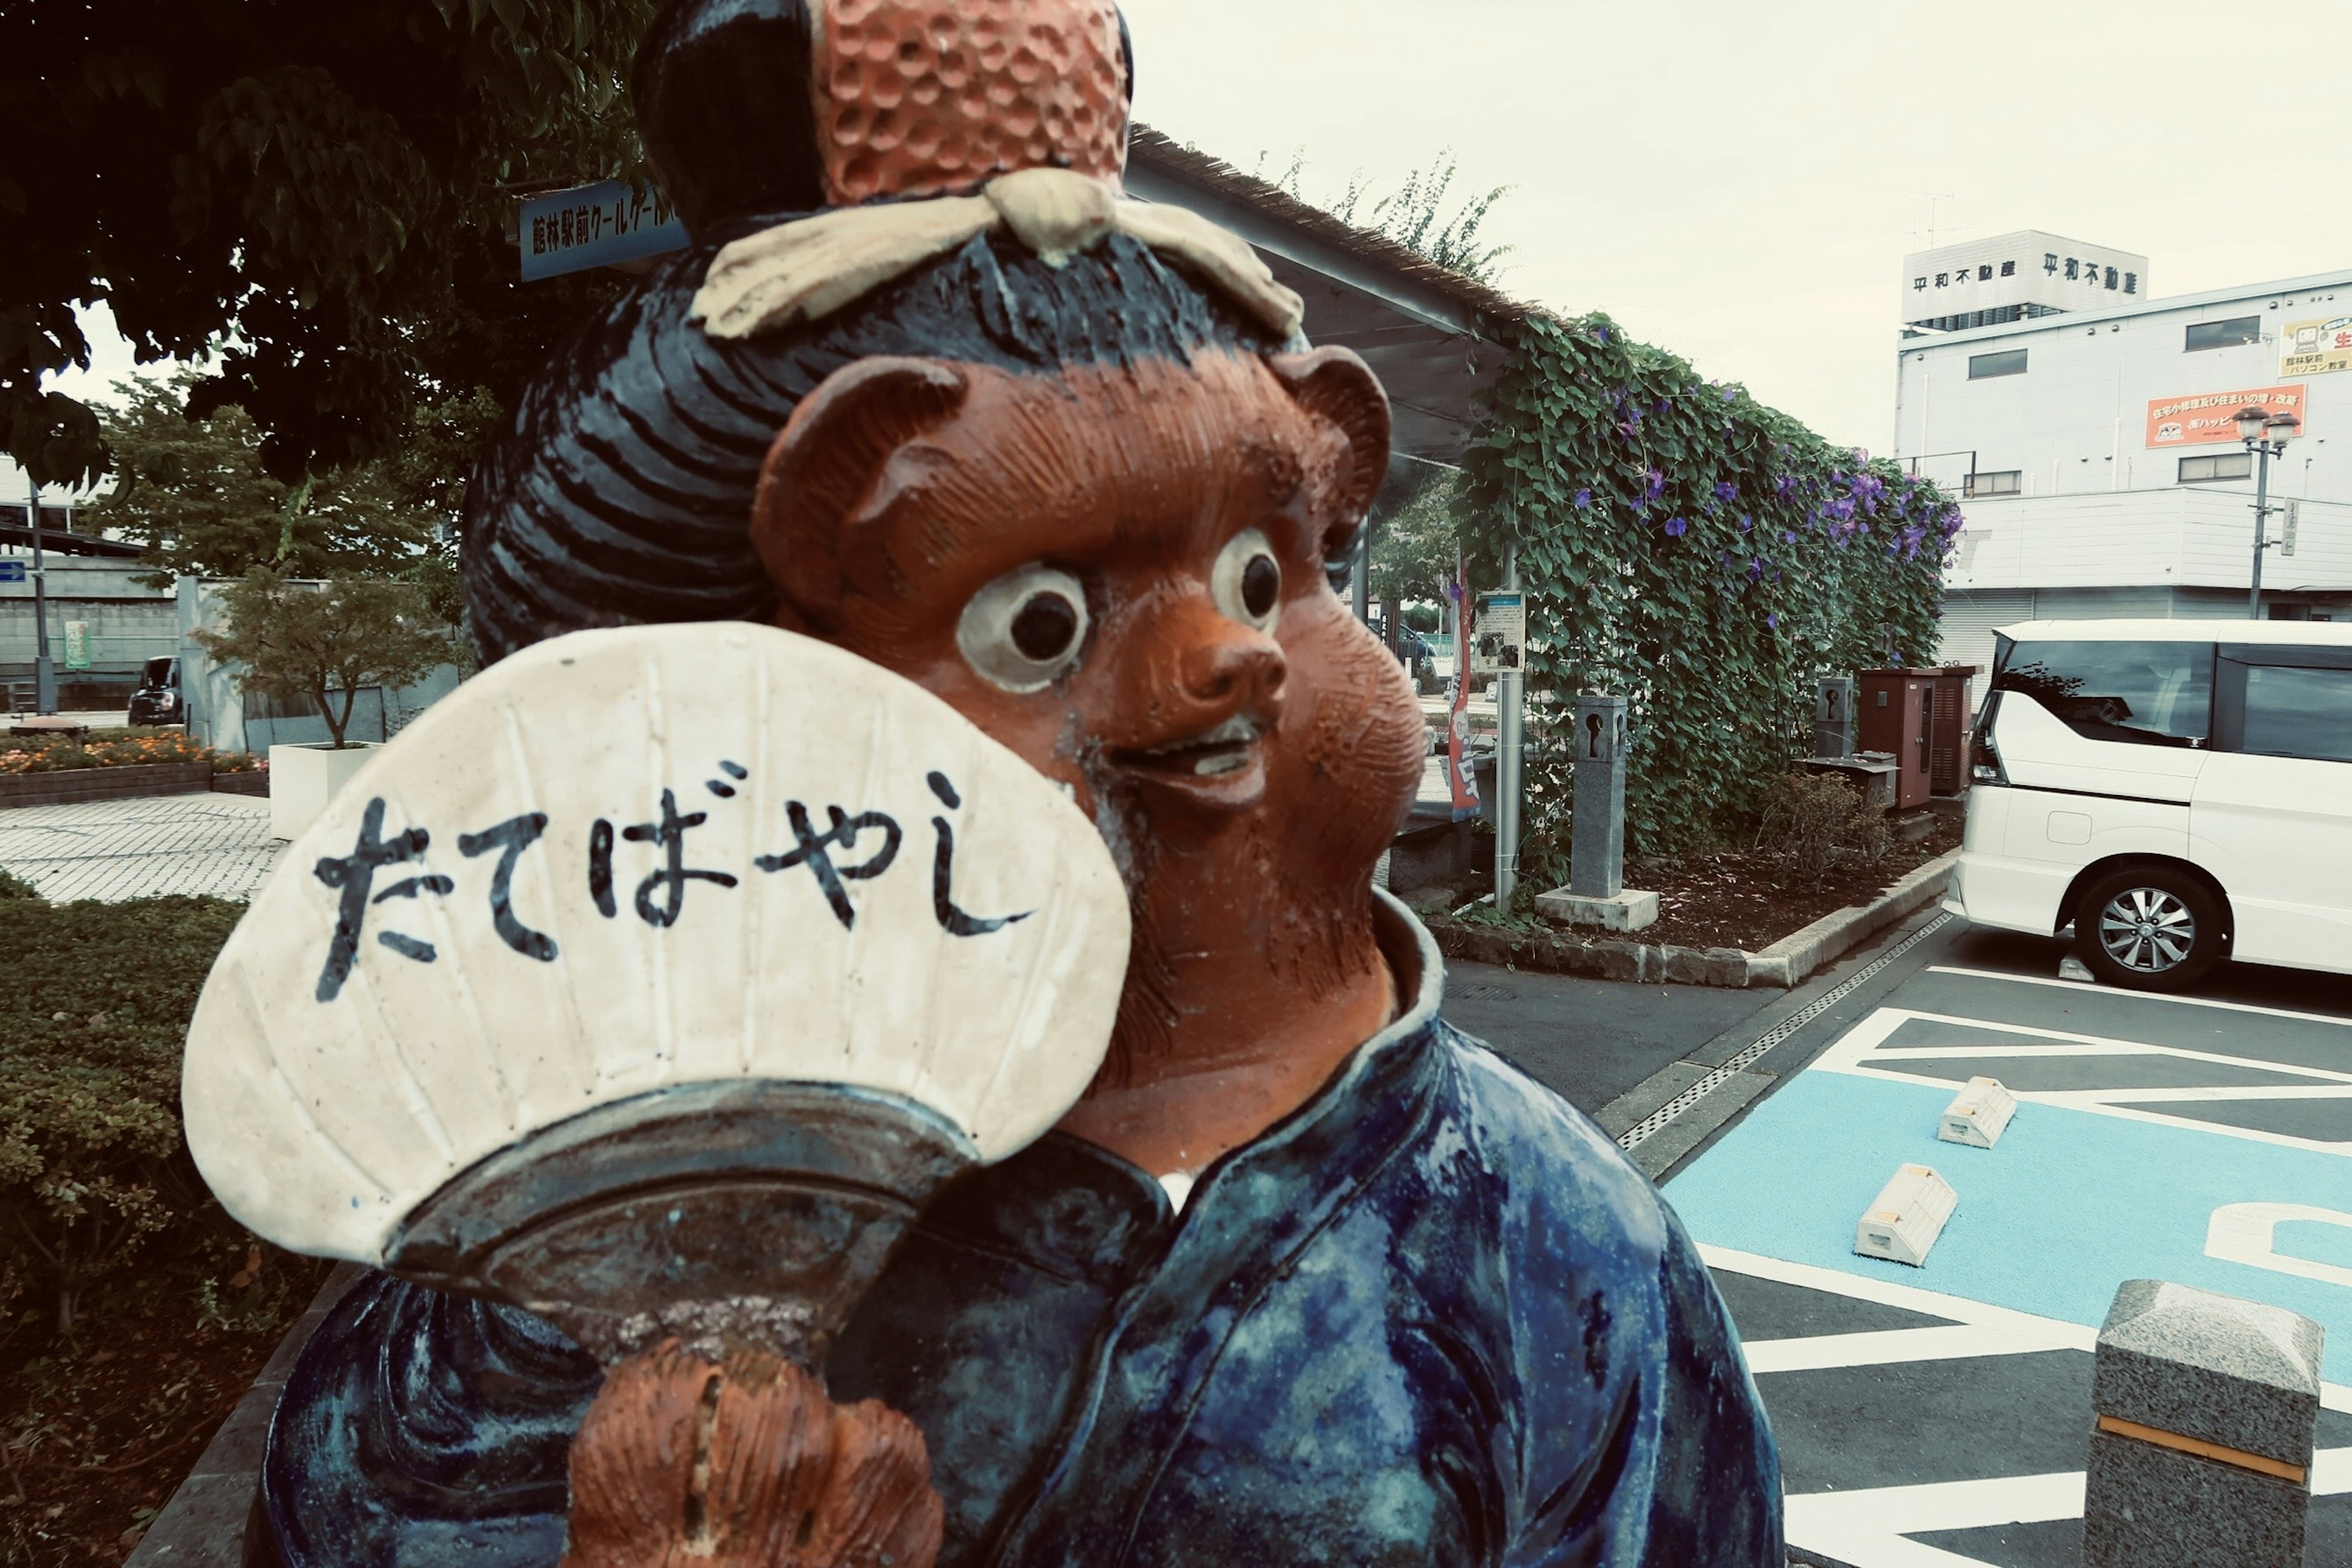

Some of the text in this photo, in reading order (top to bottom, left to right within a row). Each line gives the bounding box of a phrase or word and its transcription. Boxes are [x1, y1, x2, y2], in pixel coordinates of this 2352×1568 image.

[1913, 260, 2015, 292] 平和不動産
[2043, 252, 2137, 294] 平和不動産
[2286, 354, 2323, 366] 館林駅前
[2291, 360, 2348, 374] パソコン教室
[314, 760, 1038, 1003] たてばやし
